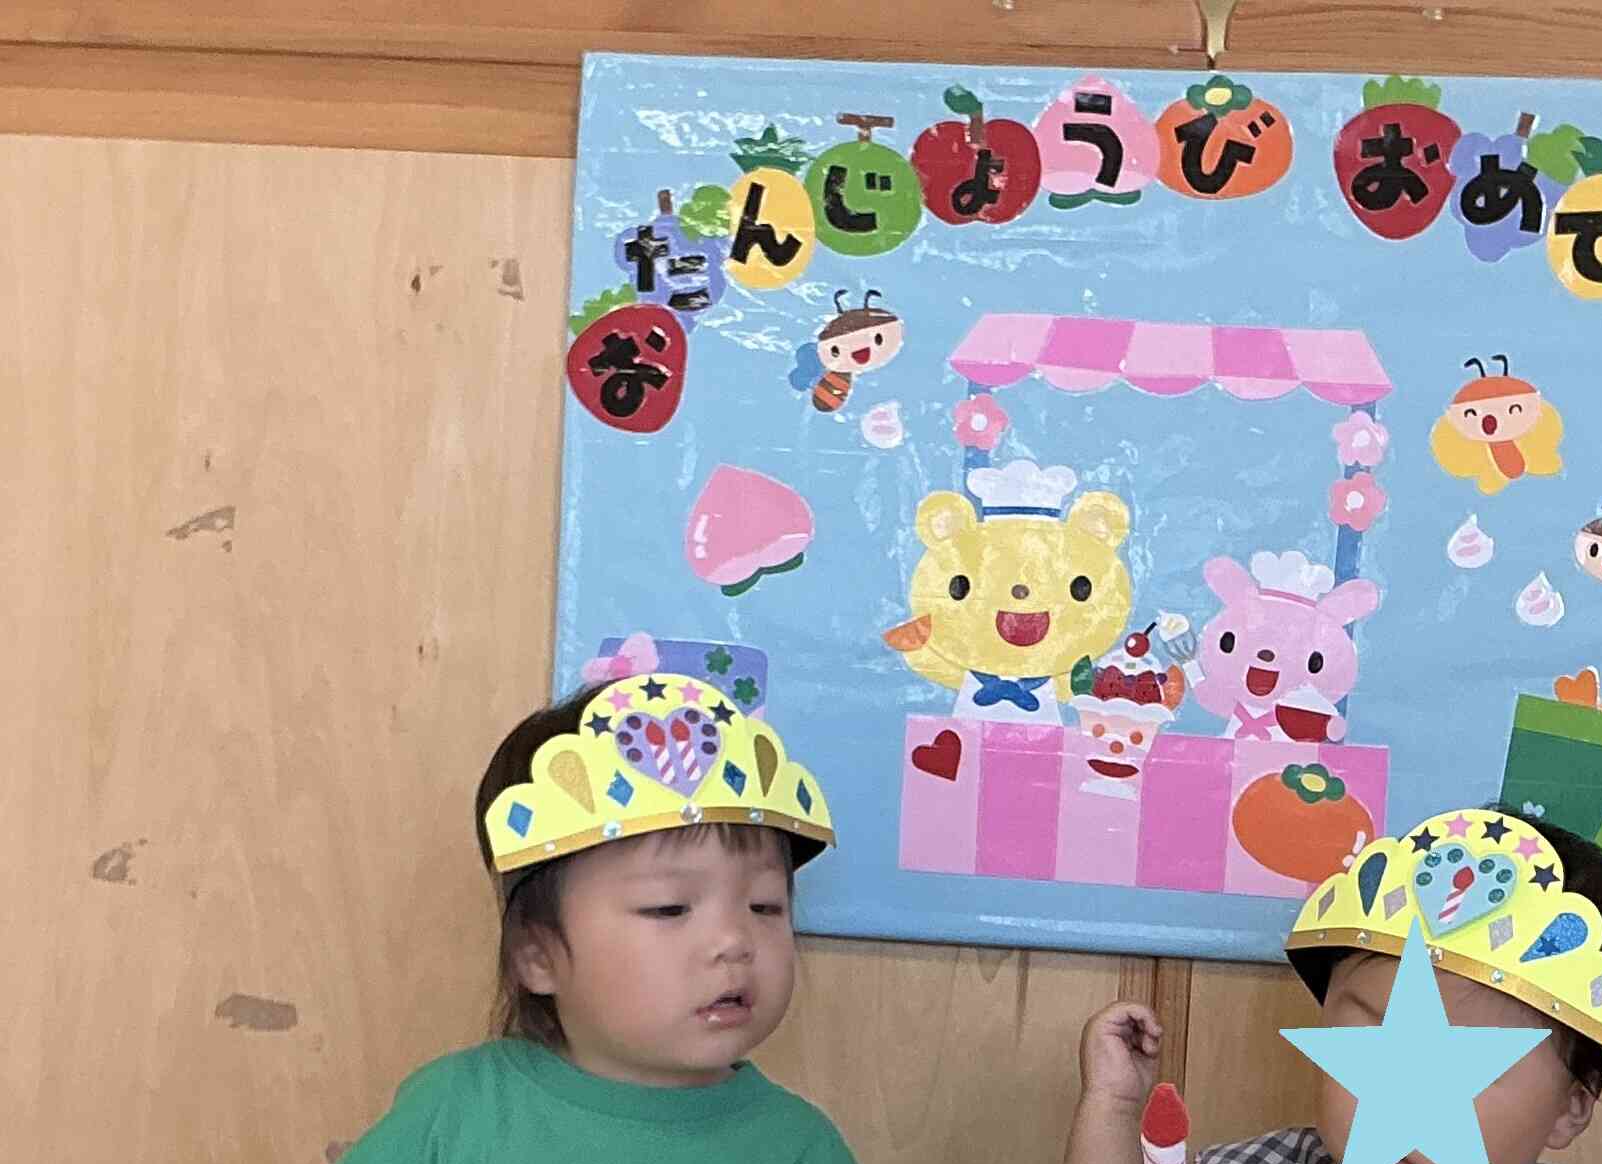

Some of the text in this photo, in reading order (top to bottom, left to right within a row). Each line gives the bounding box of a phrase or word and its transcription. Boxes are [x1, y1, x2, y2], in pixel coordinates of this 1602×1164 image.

[588, 90, 1276, 419] おたんじょうび
